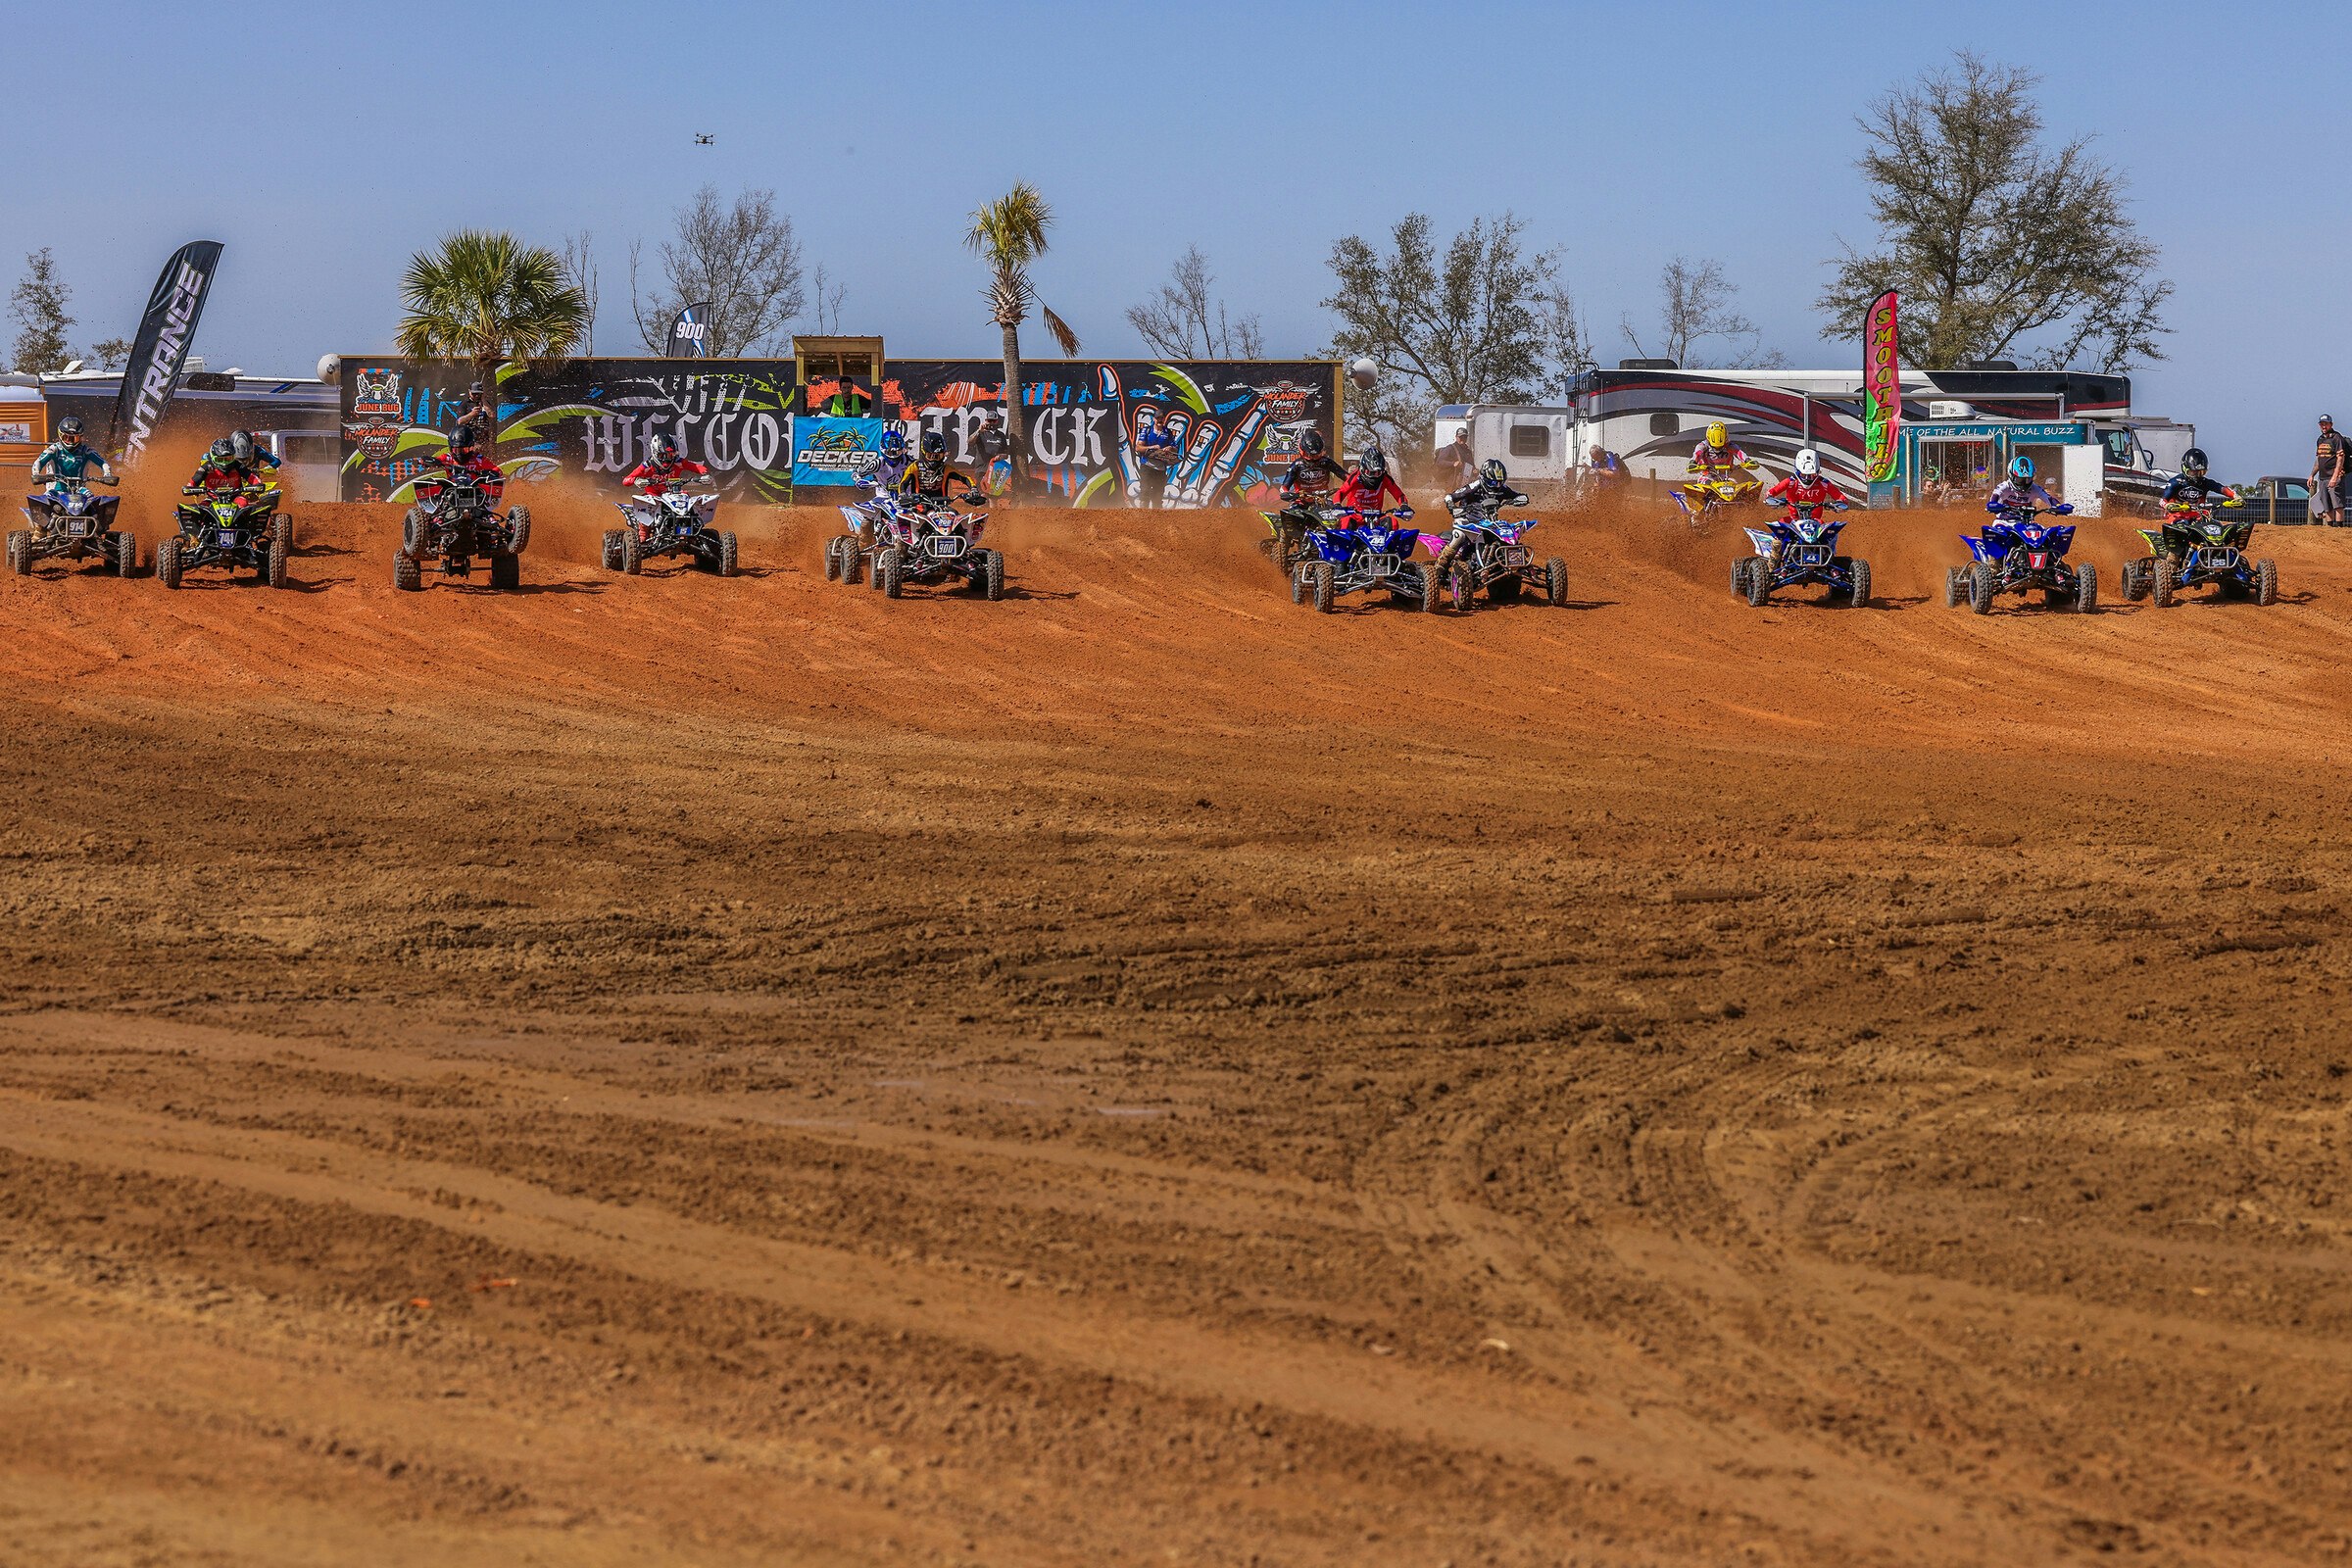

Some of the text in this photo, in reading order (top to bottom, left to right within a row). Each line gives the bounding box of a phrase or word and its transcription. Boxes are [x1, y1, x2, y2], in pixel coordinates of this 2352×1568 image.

[675, 321, 705, 341] 900
[1870, 308, 1894, 479] SMOOTHIES
[357, 403, 399, 412] JUNE BUG
[1271, 400, 1299, 409] FAMILY
[1916, 428, 1932, 437] OF
[2043, 427, 2076, 436] BUZZ
[363, 436, 391, 445] FAMILY
[796, 450, 879, 465] DECKER
[69, 521, 84, 532] 914
[938, 543, 955, 554] 900
[2033, 555, 2043, 568] 1
